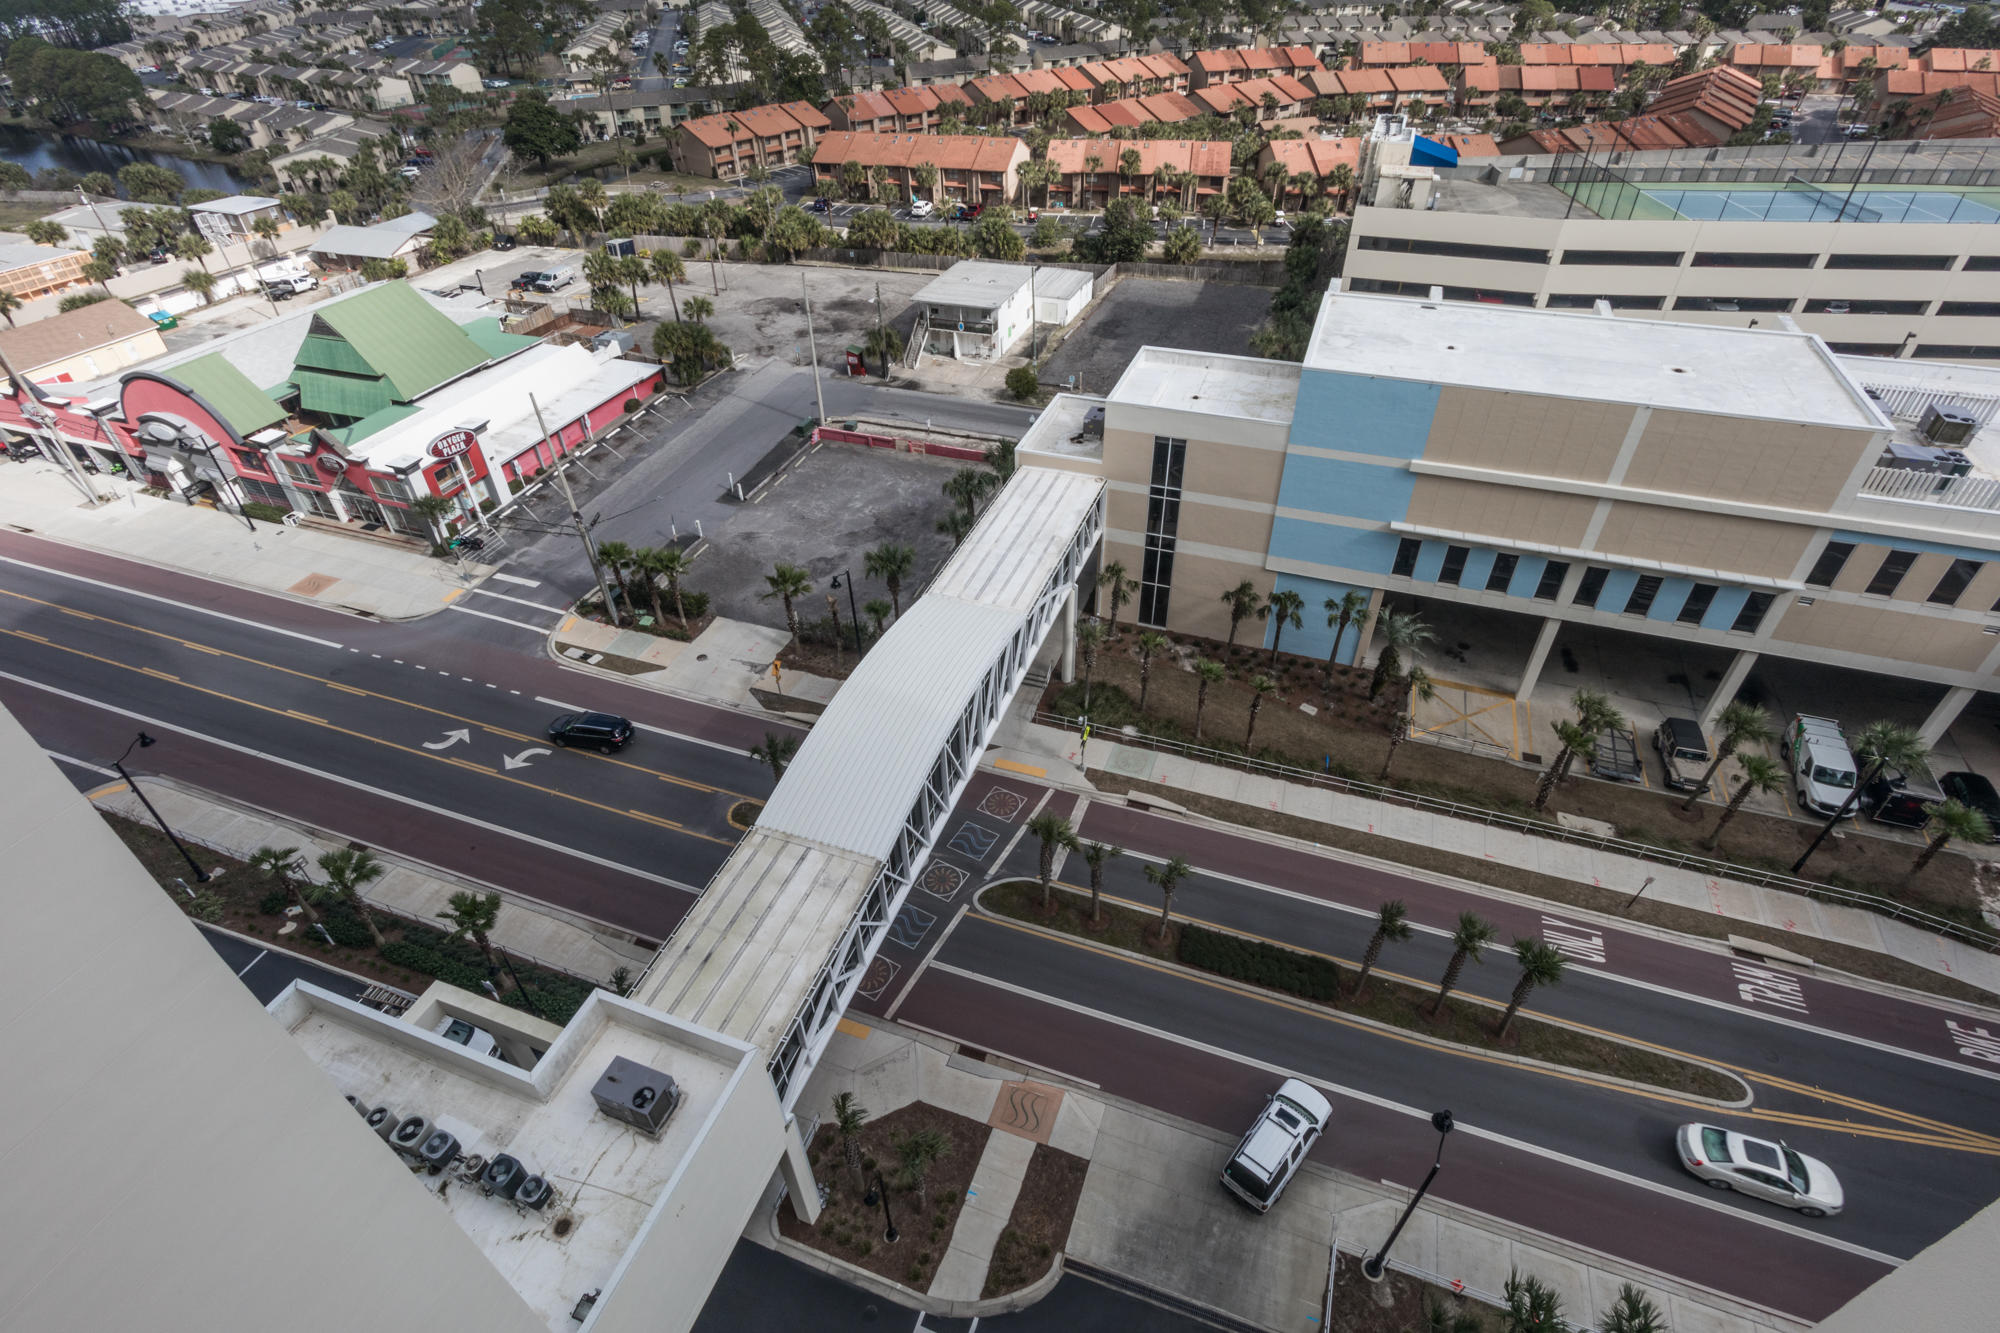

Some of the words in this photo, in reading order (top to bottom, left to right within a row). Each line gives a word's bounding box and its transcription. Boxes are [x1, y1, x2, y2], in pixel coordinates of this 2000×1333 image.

[437, 431, 466, 449] OXYGEN
[442, 441, 466, 457] PLAZA
[1541, 915, 1606, 963] ONLY
[1731, 962, 1809, 1014] TRAM
